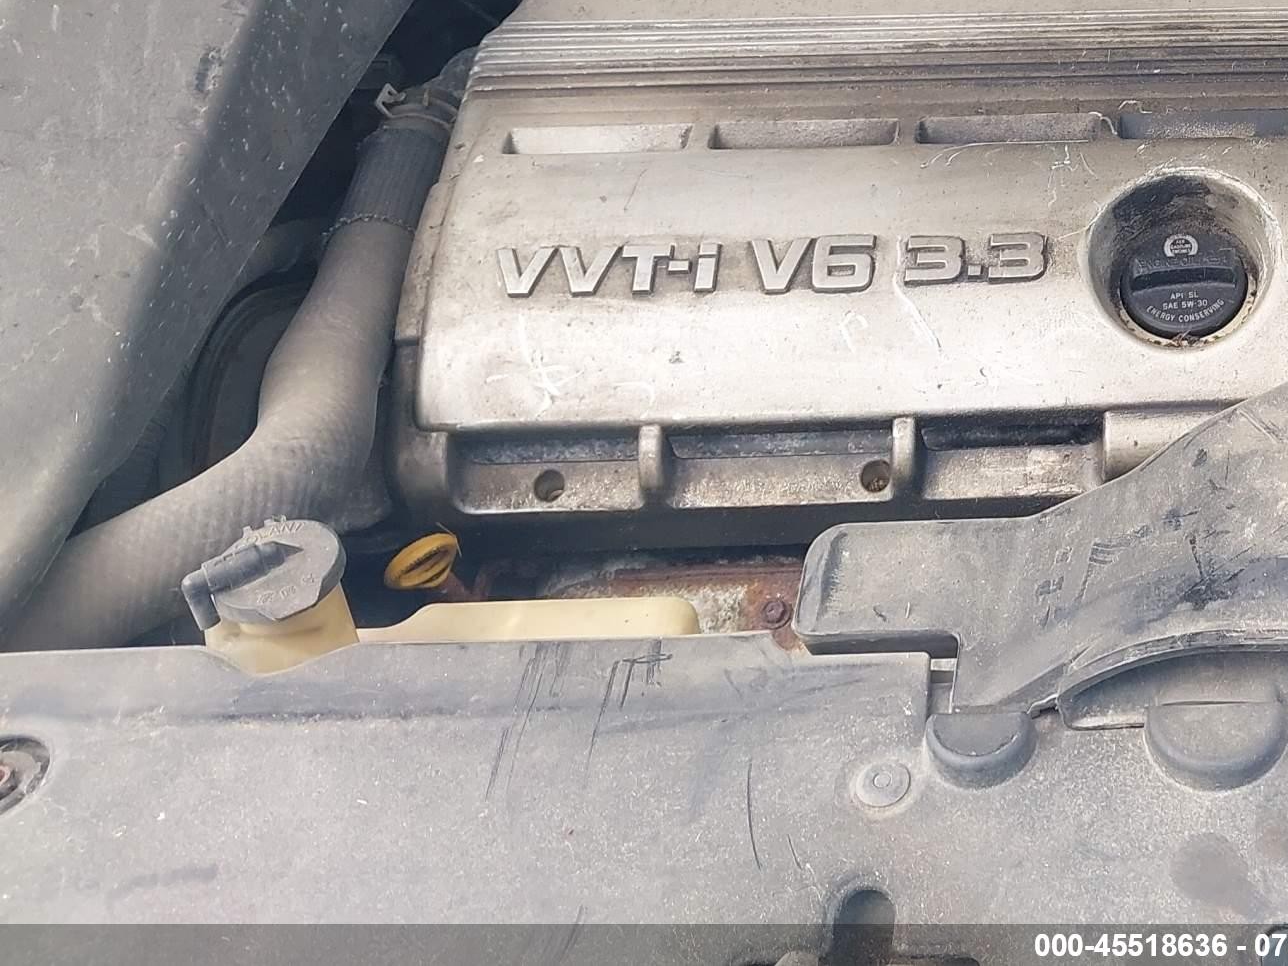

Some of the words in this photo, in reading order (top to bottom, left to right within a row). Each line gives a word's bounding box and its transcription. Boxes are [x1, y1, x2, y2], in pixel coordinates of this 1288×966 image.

[497, 242, 720, 298] VVT-i
[751, 234, 878, 295] V6
[903, 233, 1047, 286] 3.3
[1188, 291, 1199, 299] SL
[1146, 305, 1175, 322] ENERGY
[1178, 299, 1225, 323] CONSERVING
[1162, 302, 1178, 311] SAE
[1181, 299, 1208, 309] 5W-30
